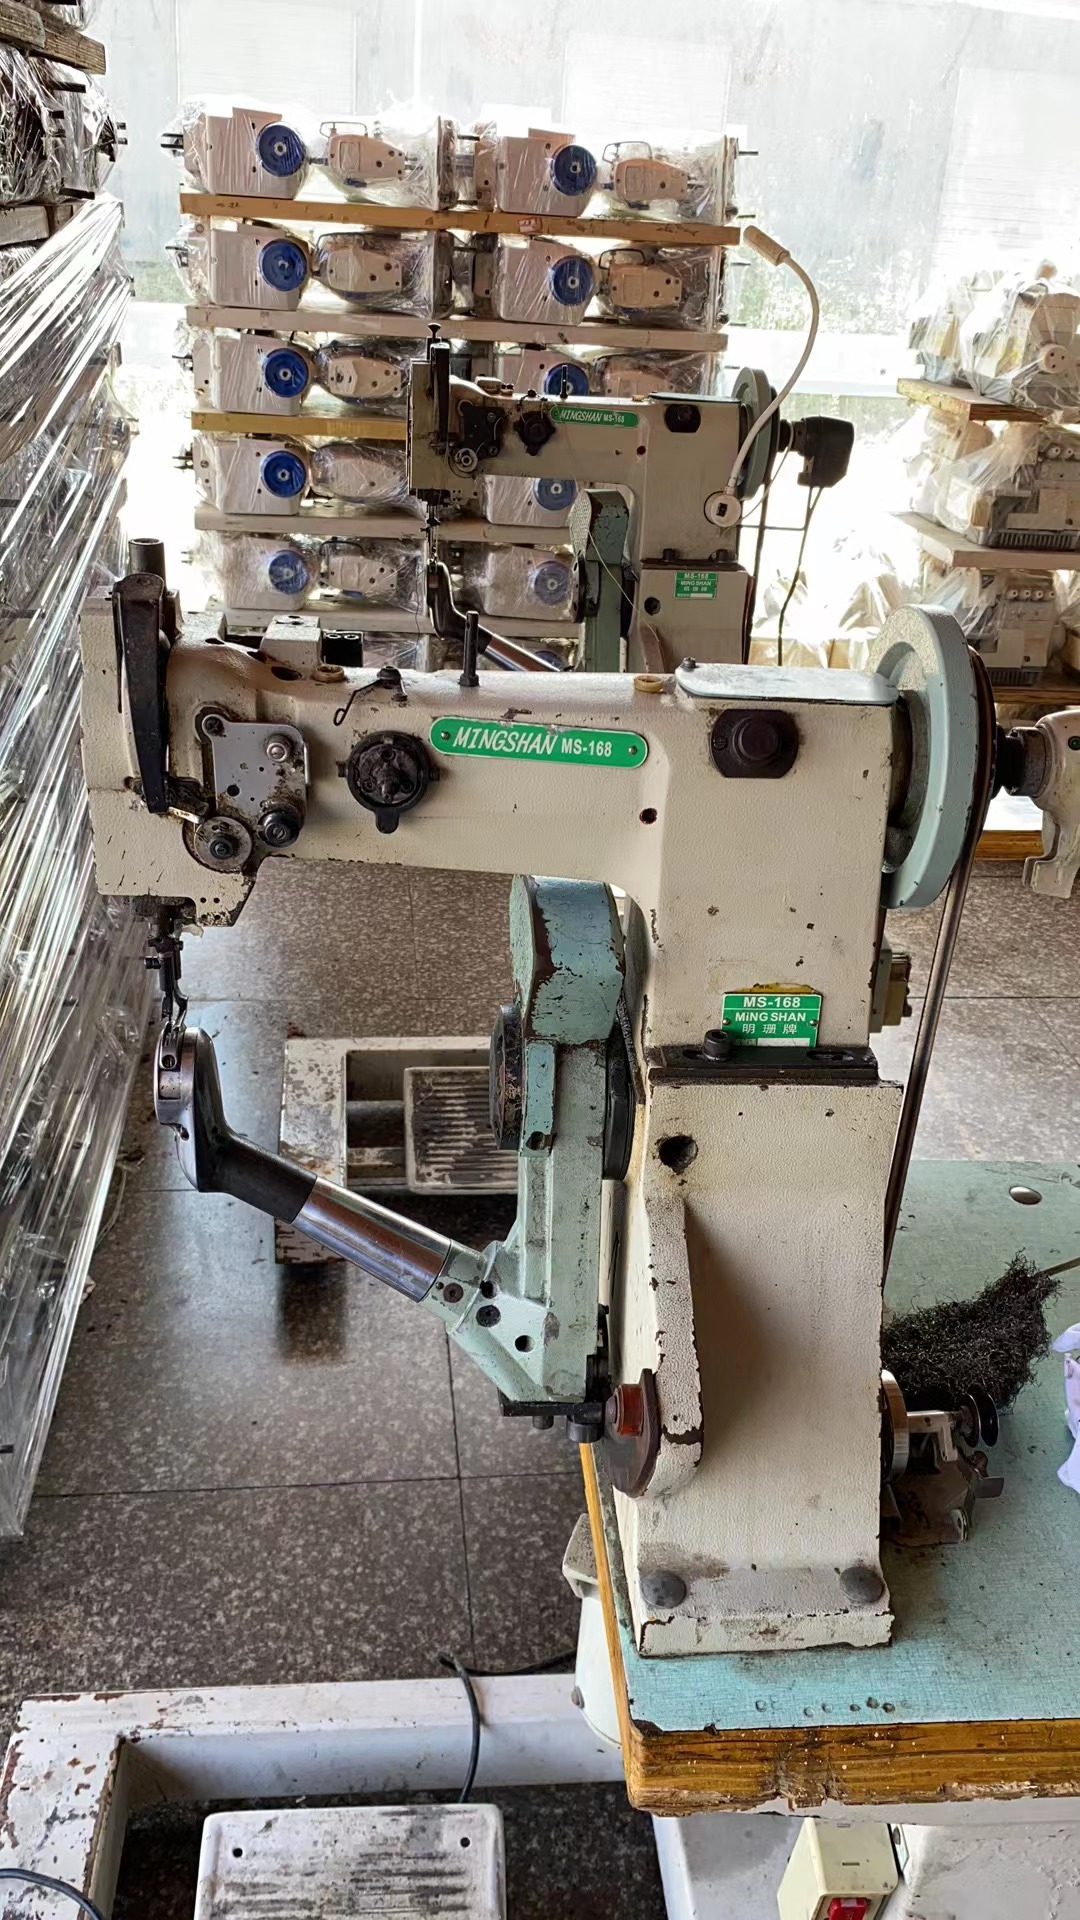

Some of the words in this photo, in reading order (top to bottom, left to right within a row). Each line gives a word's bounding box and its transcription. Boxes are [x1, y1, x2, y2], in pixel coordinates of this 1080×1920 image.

[560, 409, 602, 421] MINGSHAN
[453, 727, 557, 755] MINGSHAN
[561, 738, 612, 757] MS-168
[743, 996, 801, 1008] MS-168
[771, 1012, 806, 1022] SHAN
[742, 1023, 797, 1034] 明珊牌
